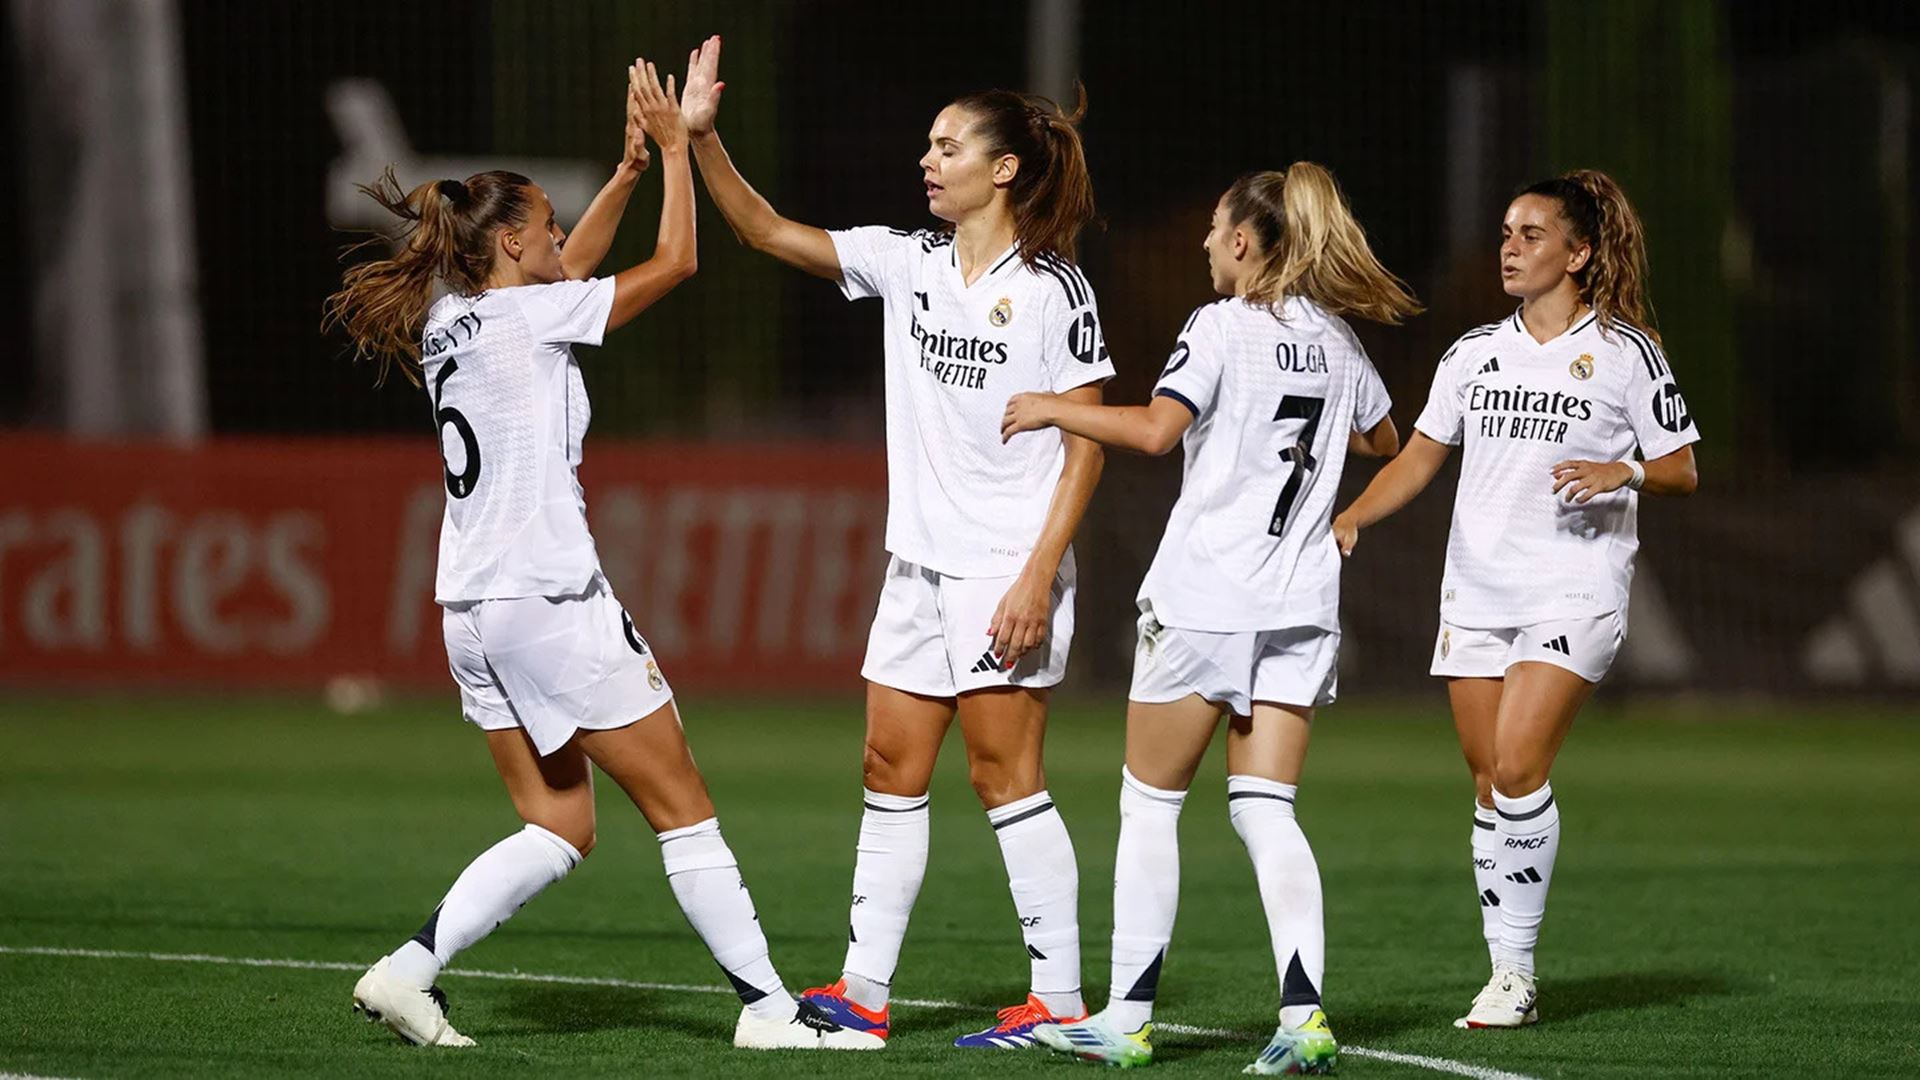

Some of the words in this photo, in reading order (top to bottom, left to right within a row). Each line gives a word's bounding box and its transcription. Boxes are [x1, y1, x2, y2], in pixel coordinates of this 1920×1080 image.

[910, 312, 1008, 364] Emirates
[1276, 342, 1328, 373] OLGA
[1470, 384, 1593, 422] Emirates
[1656, 384, 1689, 433] hp
[434, 355, 482, 499] 6
[1480, 415, 1505, 438] FLY
[1509, 416, 1569, 444] BETTER
[1268, 394, 1326, 538] 7
[1504, 836, 1549, 850] RMCF
